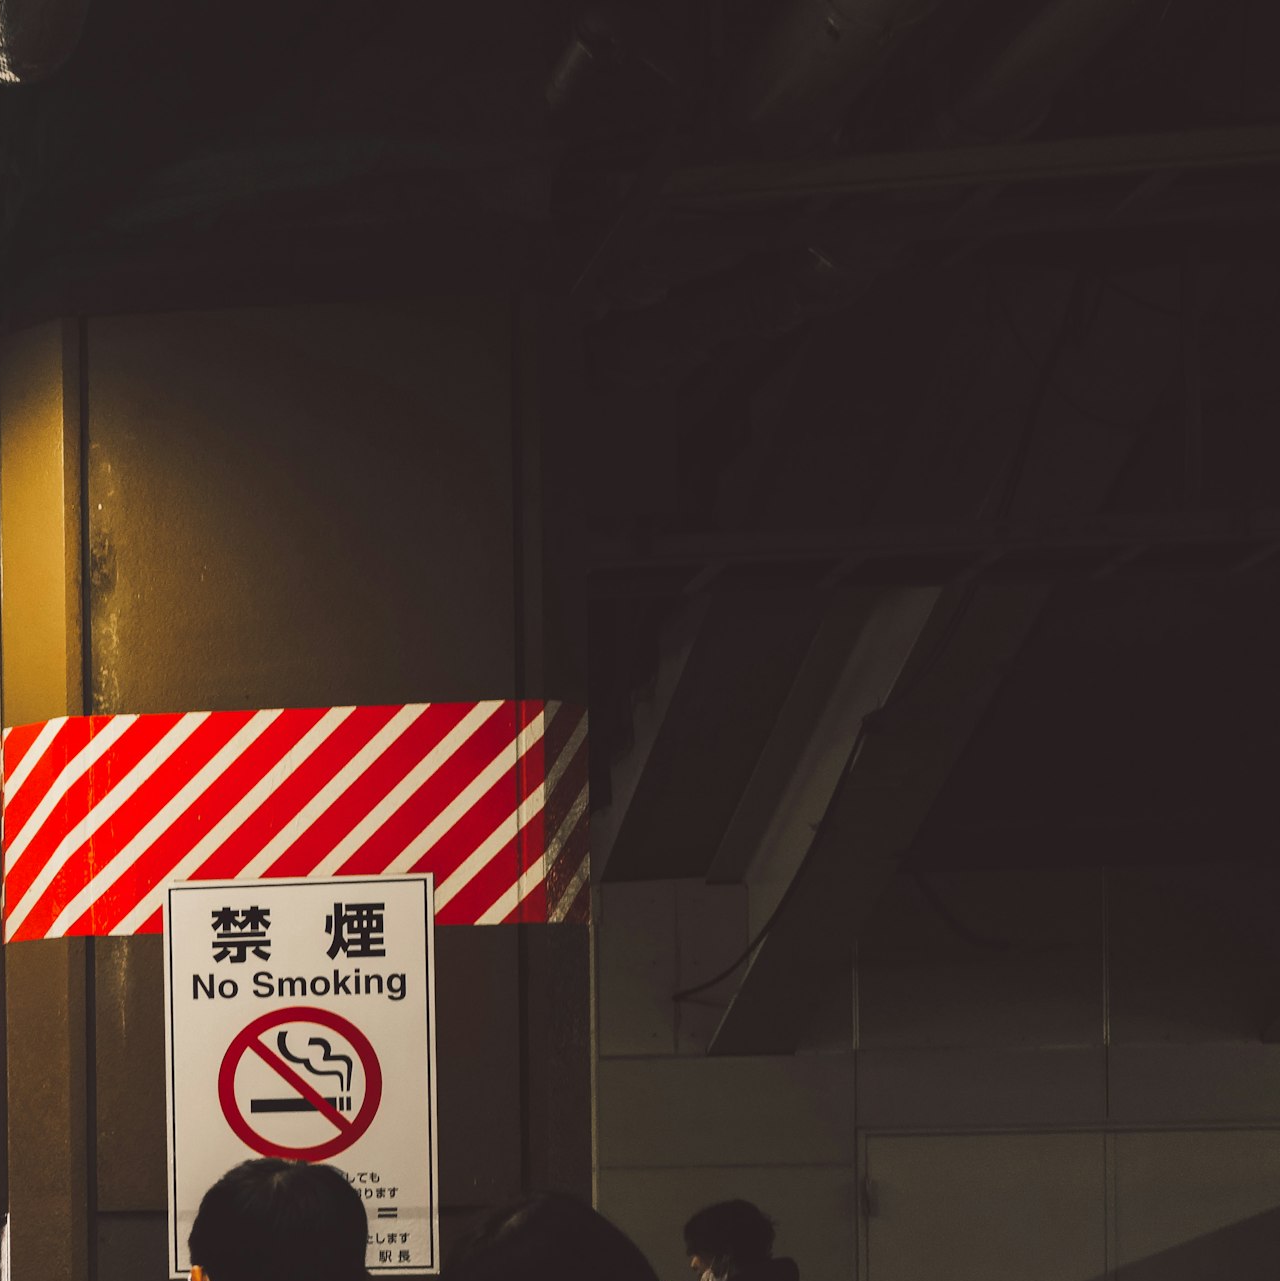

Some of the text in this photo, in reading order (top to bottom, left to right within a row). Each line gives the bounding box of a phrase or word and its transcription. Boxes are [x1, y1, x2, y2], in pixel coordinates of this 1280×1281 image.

[211, 902, 387, 964] 禁煙
[192, 968, 408, 1001] No Smoking
